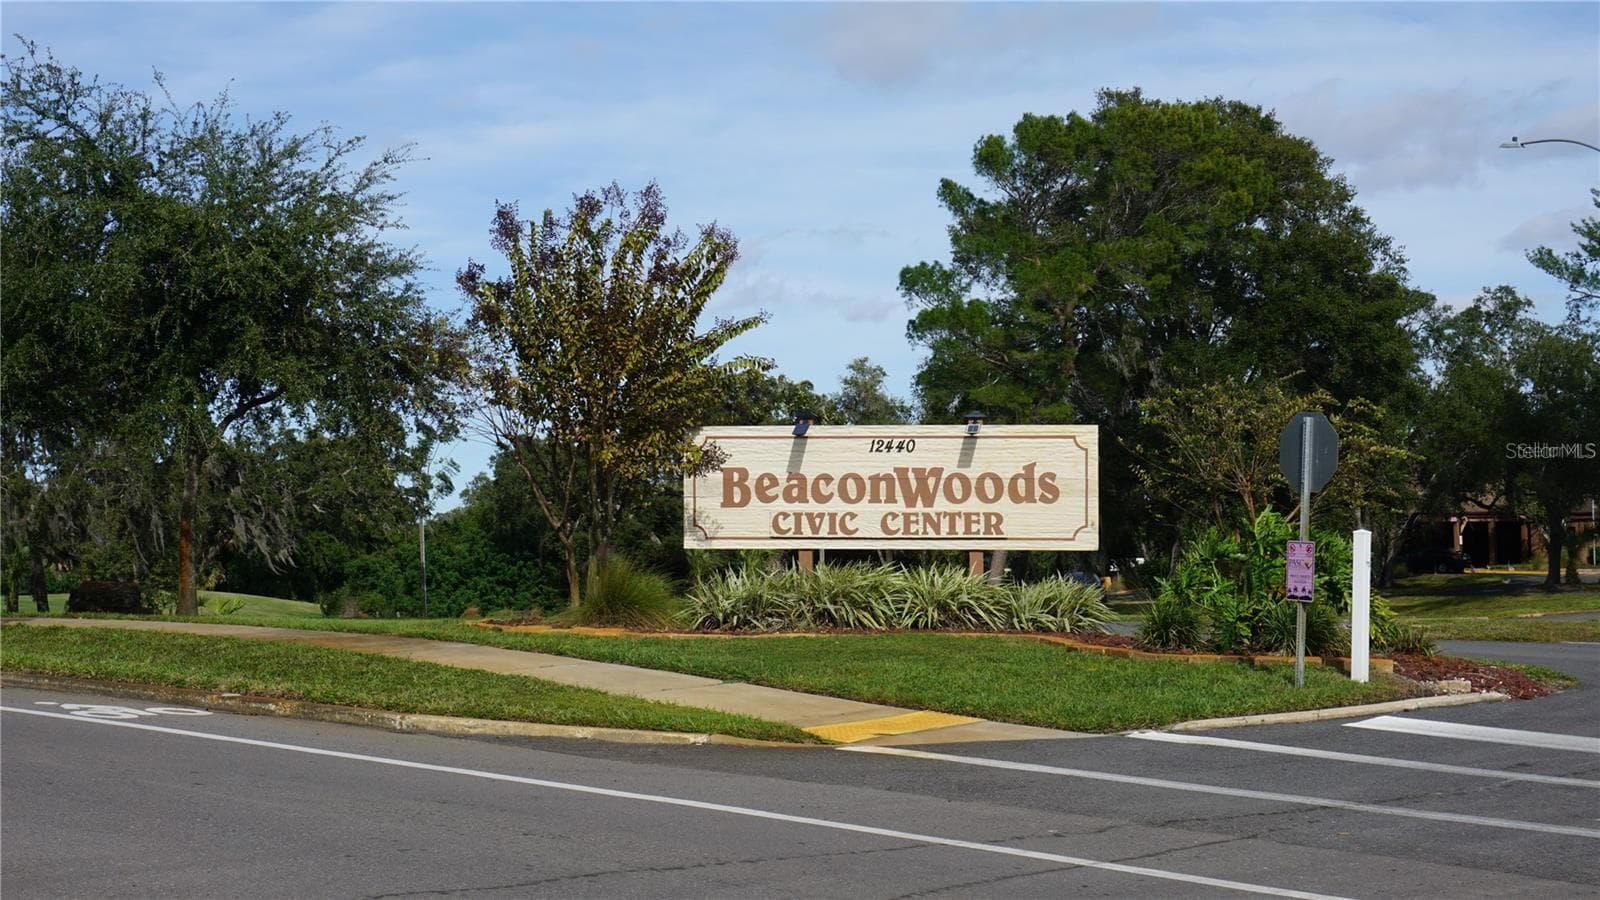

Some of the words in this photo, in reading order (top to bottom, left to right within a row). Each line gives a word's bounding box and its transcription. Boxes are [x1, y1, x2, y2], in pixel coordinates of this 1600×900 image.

[869, 439, 916, 453] 12440
[720, 462, 1060, 508] BeaconWoods
[771, 512, 859, 535] CIVIC
[880, 511, 1005, 536] CENTER
